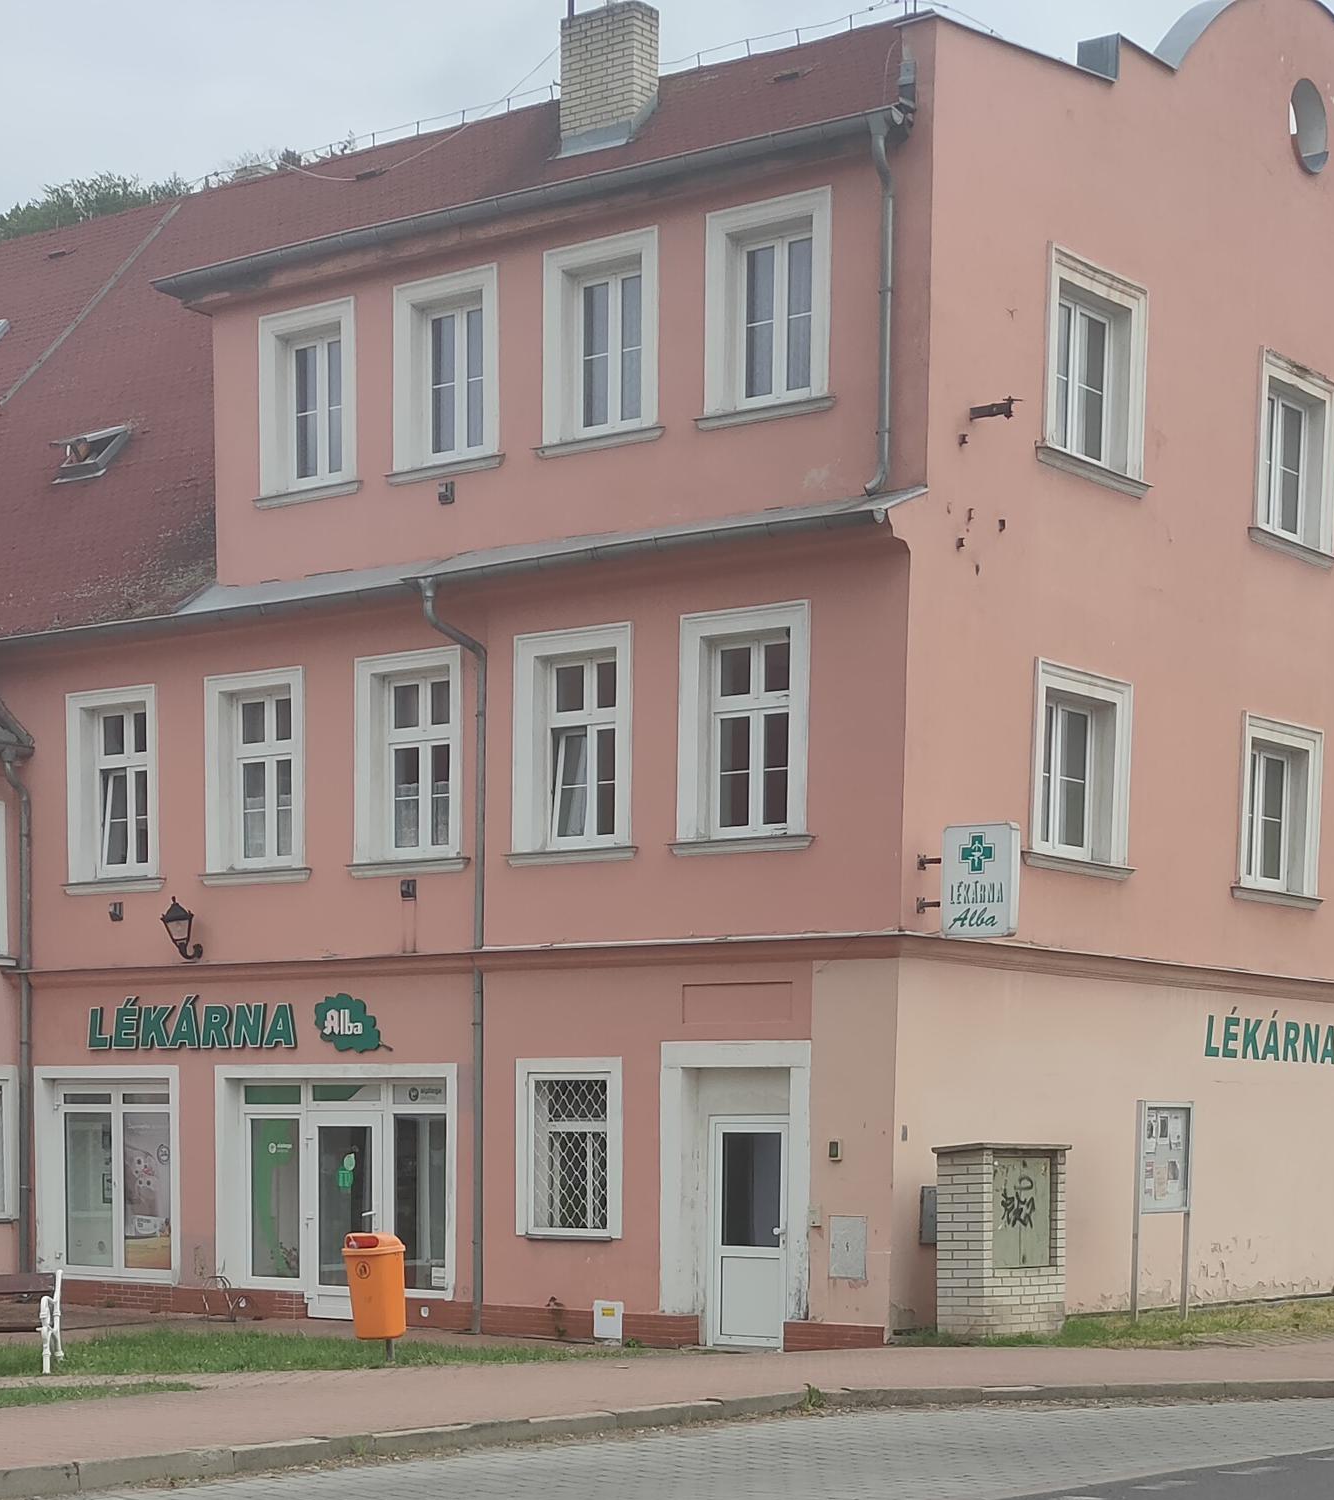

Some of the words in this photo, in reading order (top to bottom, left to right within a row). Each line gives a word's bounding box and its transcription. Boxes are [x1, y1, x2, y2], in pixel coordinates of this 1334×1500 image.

[950, 881, 1004, 904] LÉKÁRNA
[949, 907, 999, 929] Alba
[87, 994, 298, 1051] LÉKÁRNA
[323, 1009, 364, 1036] Alba
